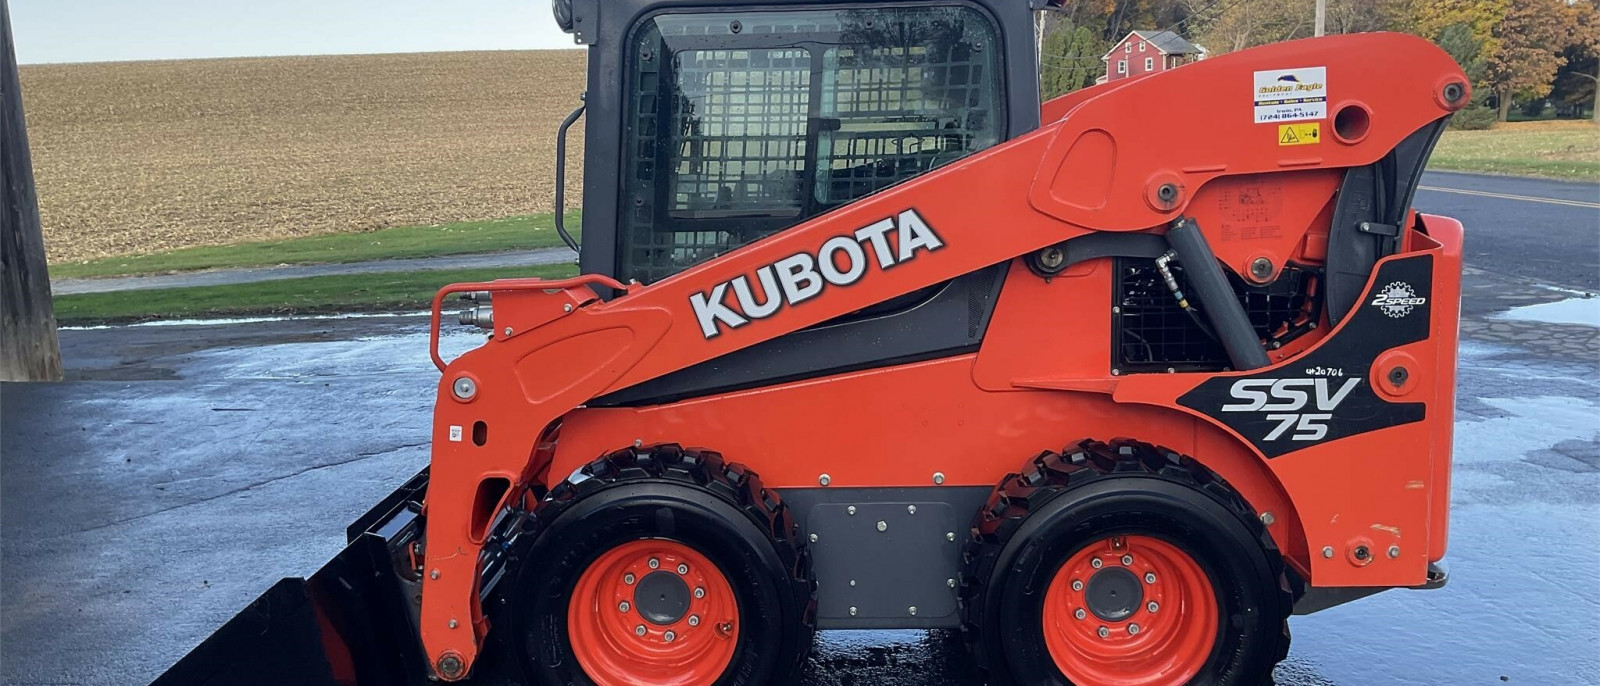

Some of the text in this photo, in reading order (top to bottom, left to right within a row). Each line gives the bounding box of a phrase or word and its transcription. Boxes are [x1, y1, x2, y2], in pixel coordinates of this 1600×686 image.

[1259, 83, 1323, 93] Golden Eagle
[1282, 111, 1319, 119] 864-5147
[689, 209, 943, 338] KUBOTA
[1221, 378, 1362, 412] SSV
[1262, 413, 1332, 441] 75
